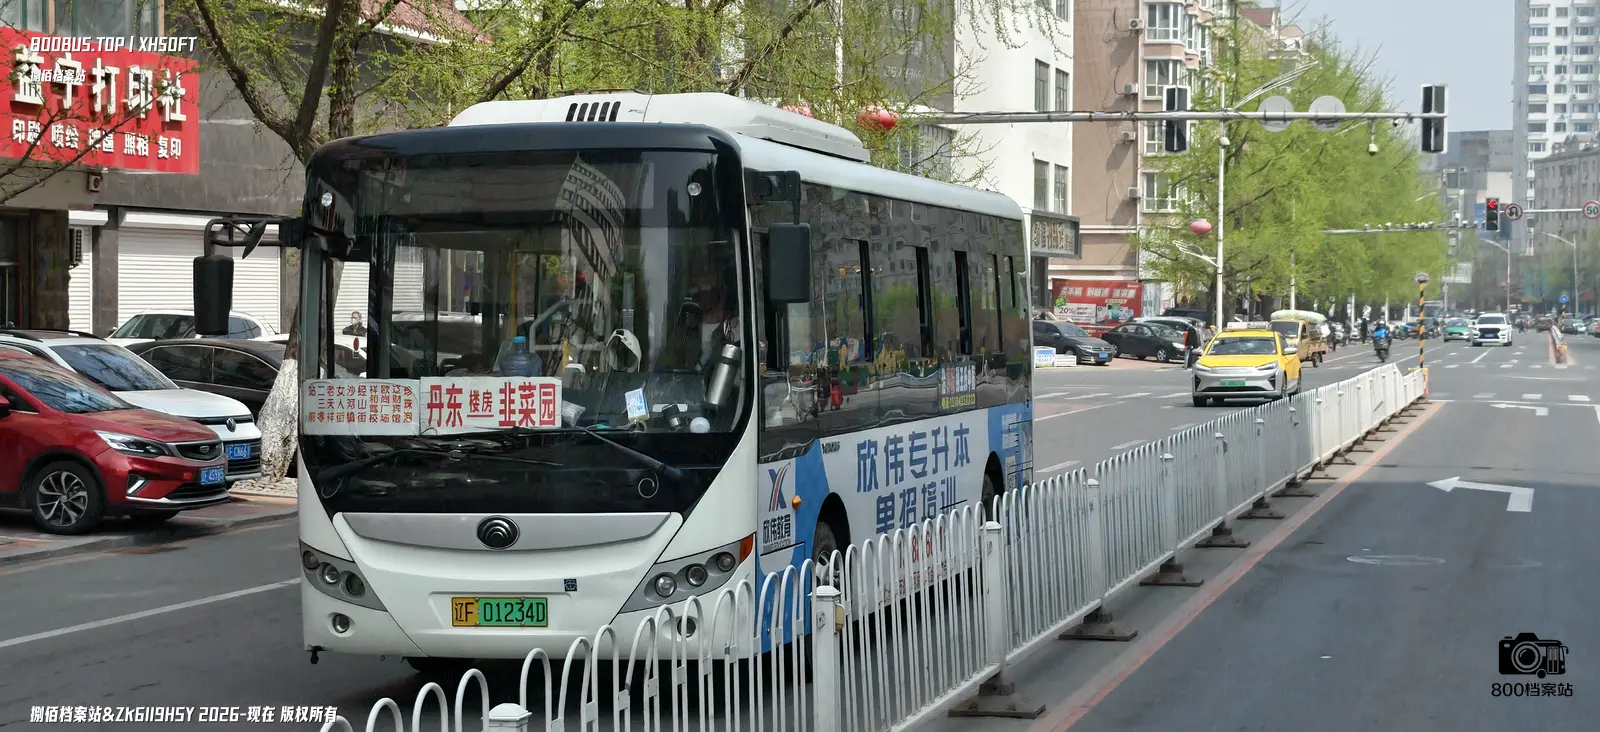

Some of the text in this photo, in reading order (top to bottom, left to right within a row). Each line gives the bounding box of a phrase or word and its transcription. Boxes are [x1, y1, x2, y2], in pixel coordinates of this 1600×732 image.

[124, 132, 149, 156] 照相
[157, 135, 182, 159] 复印
[1587, 205, 1599, 216] 50
[427, 382, 556, 427] 丹东 楼房 韭菜园
[857, 422, 970, 493] 欣伟专升本
[876, 475, 957, 535] 单招培训
[763, 514, 791, 544] 欣伟教育
